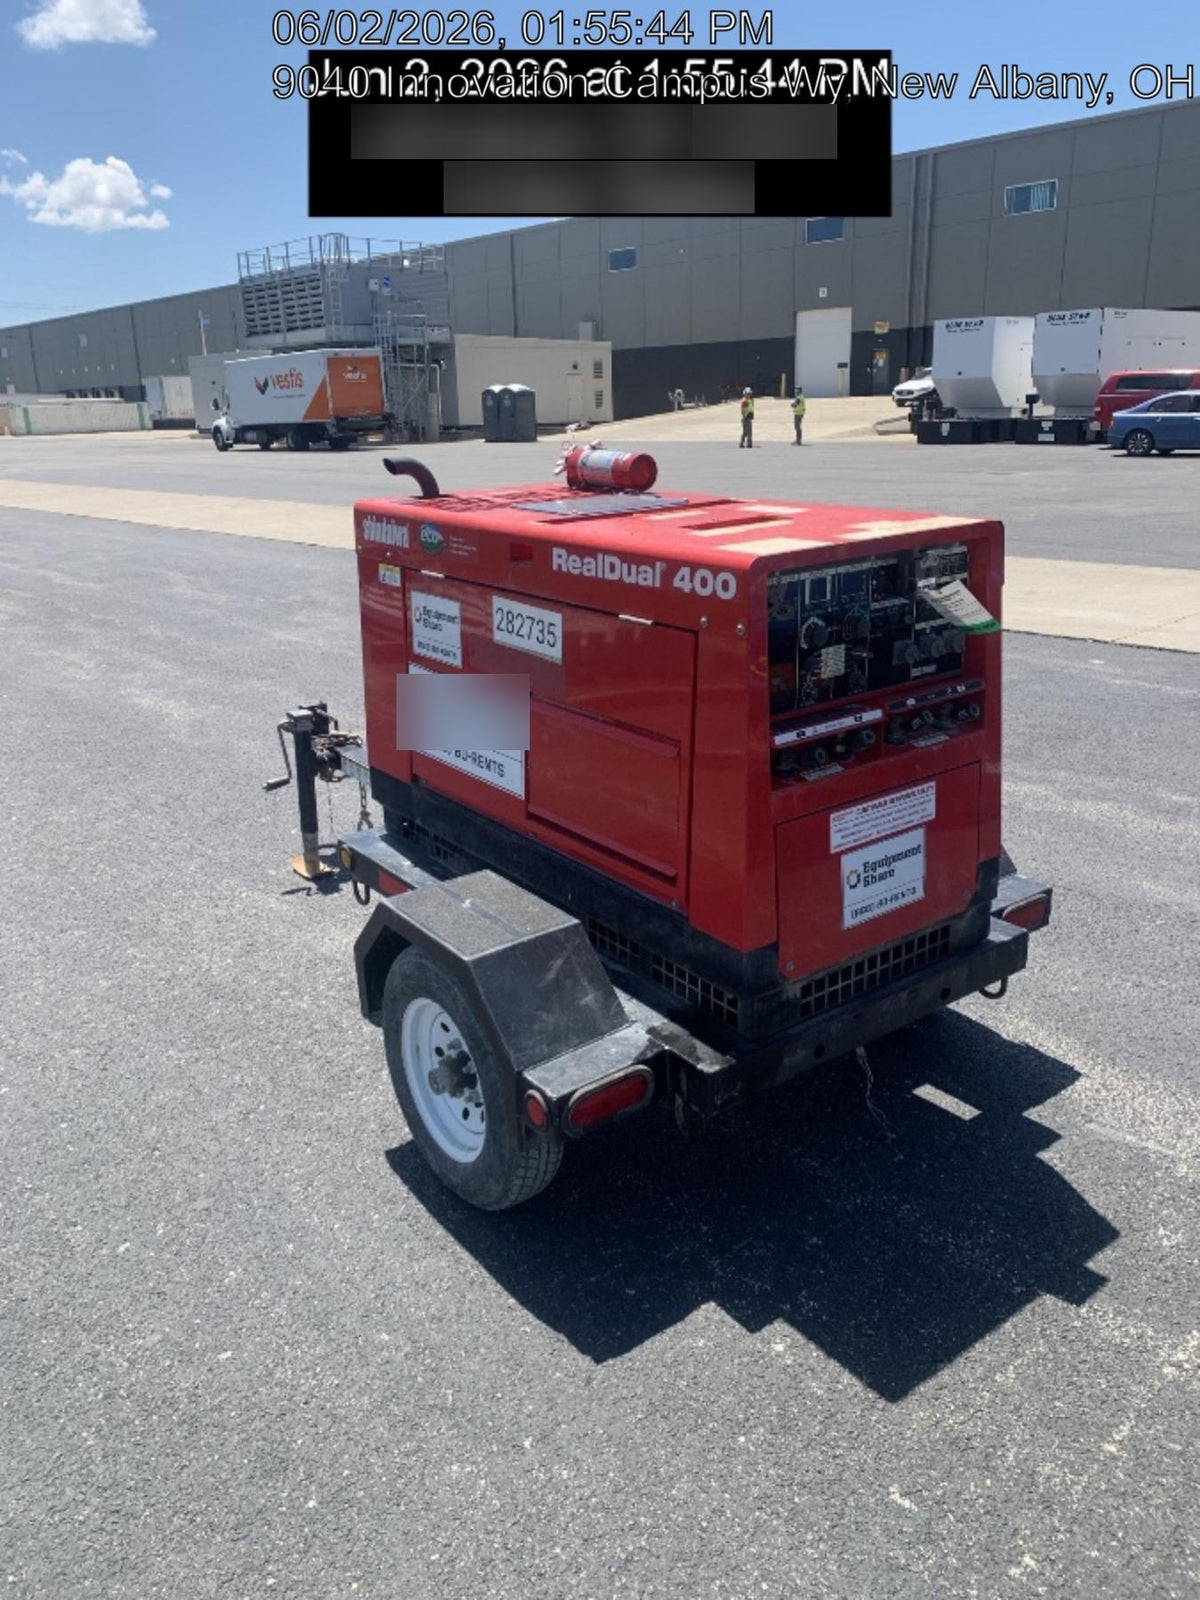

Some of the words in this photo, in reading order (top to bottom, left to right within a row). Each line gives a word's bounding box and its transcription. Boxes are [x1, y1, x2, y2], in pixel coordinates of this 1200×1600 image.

[270, 367, 305, 391] vestis
[552, 547, 662, 588] RealDual
[673, 566, 738, 601] 400
[495, 607, 557, 648] 282735
[862, 844, 922, 874] Equipment
[862, 868, 896, 888] Share
